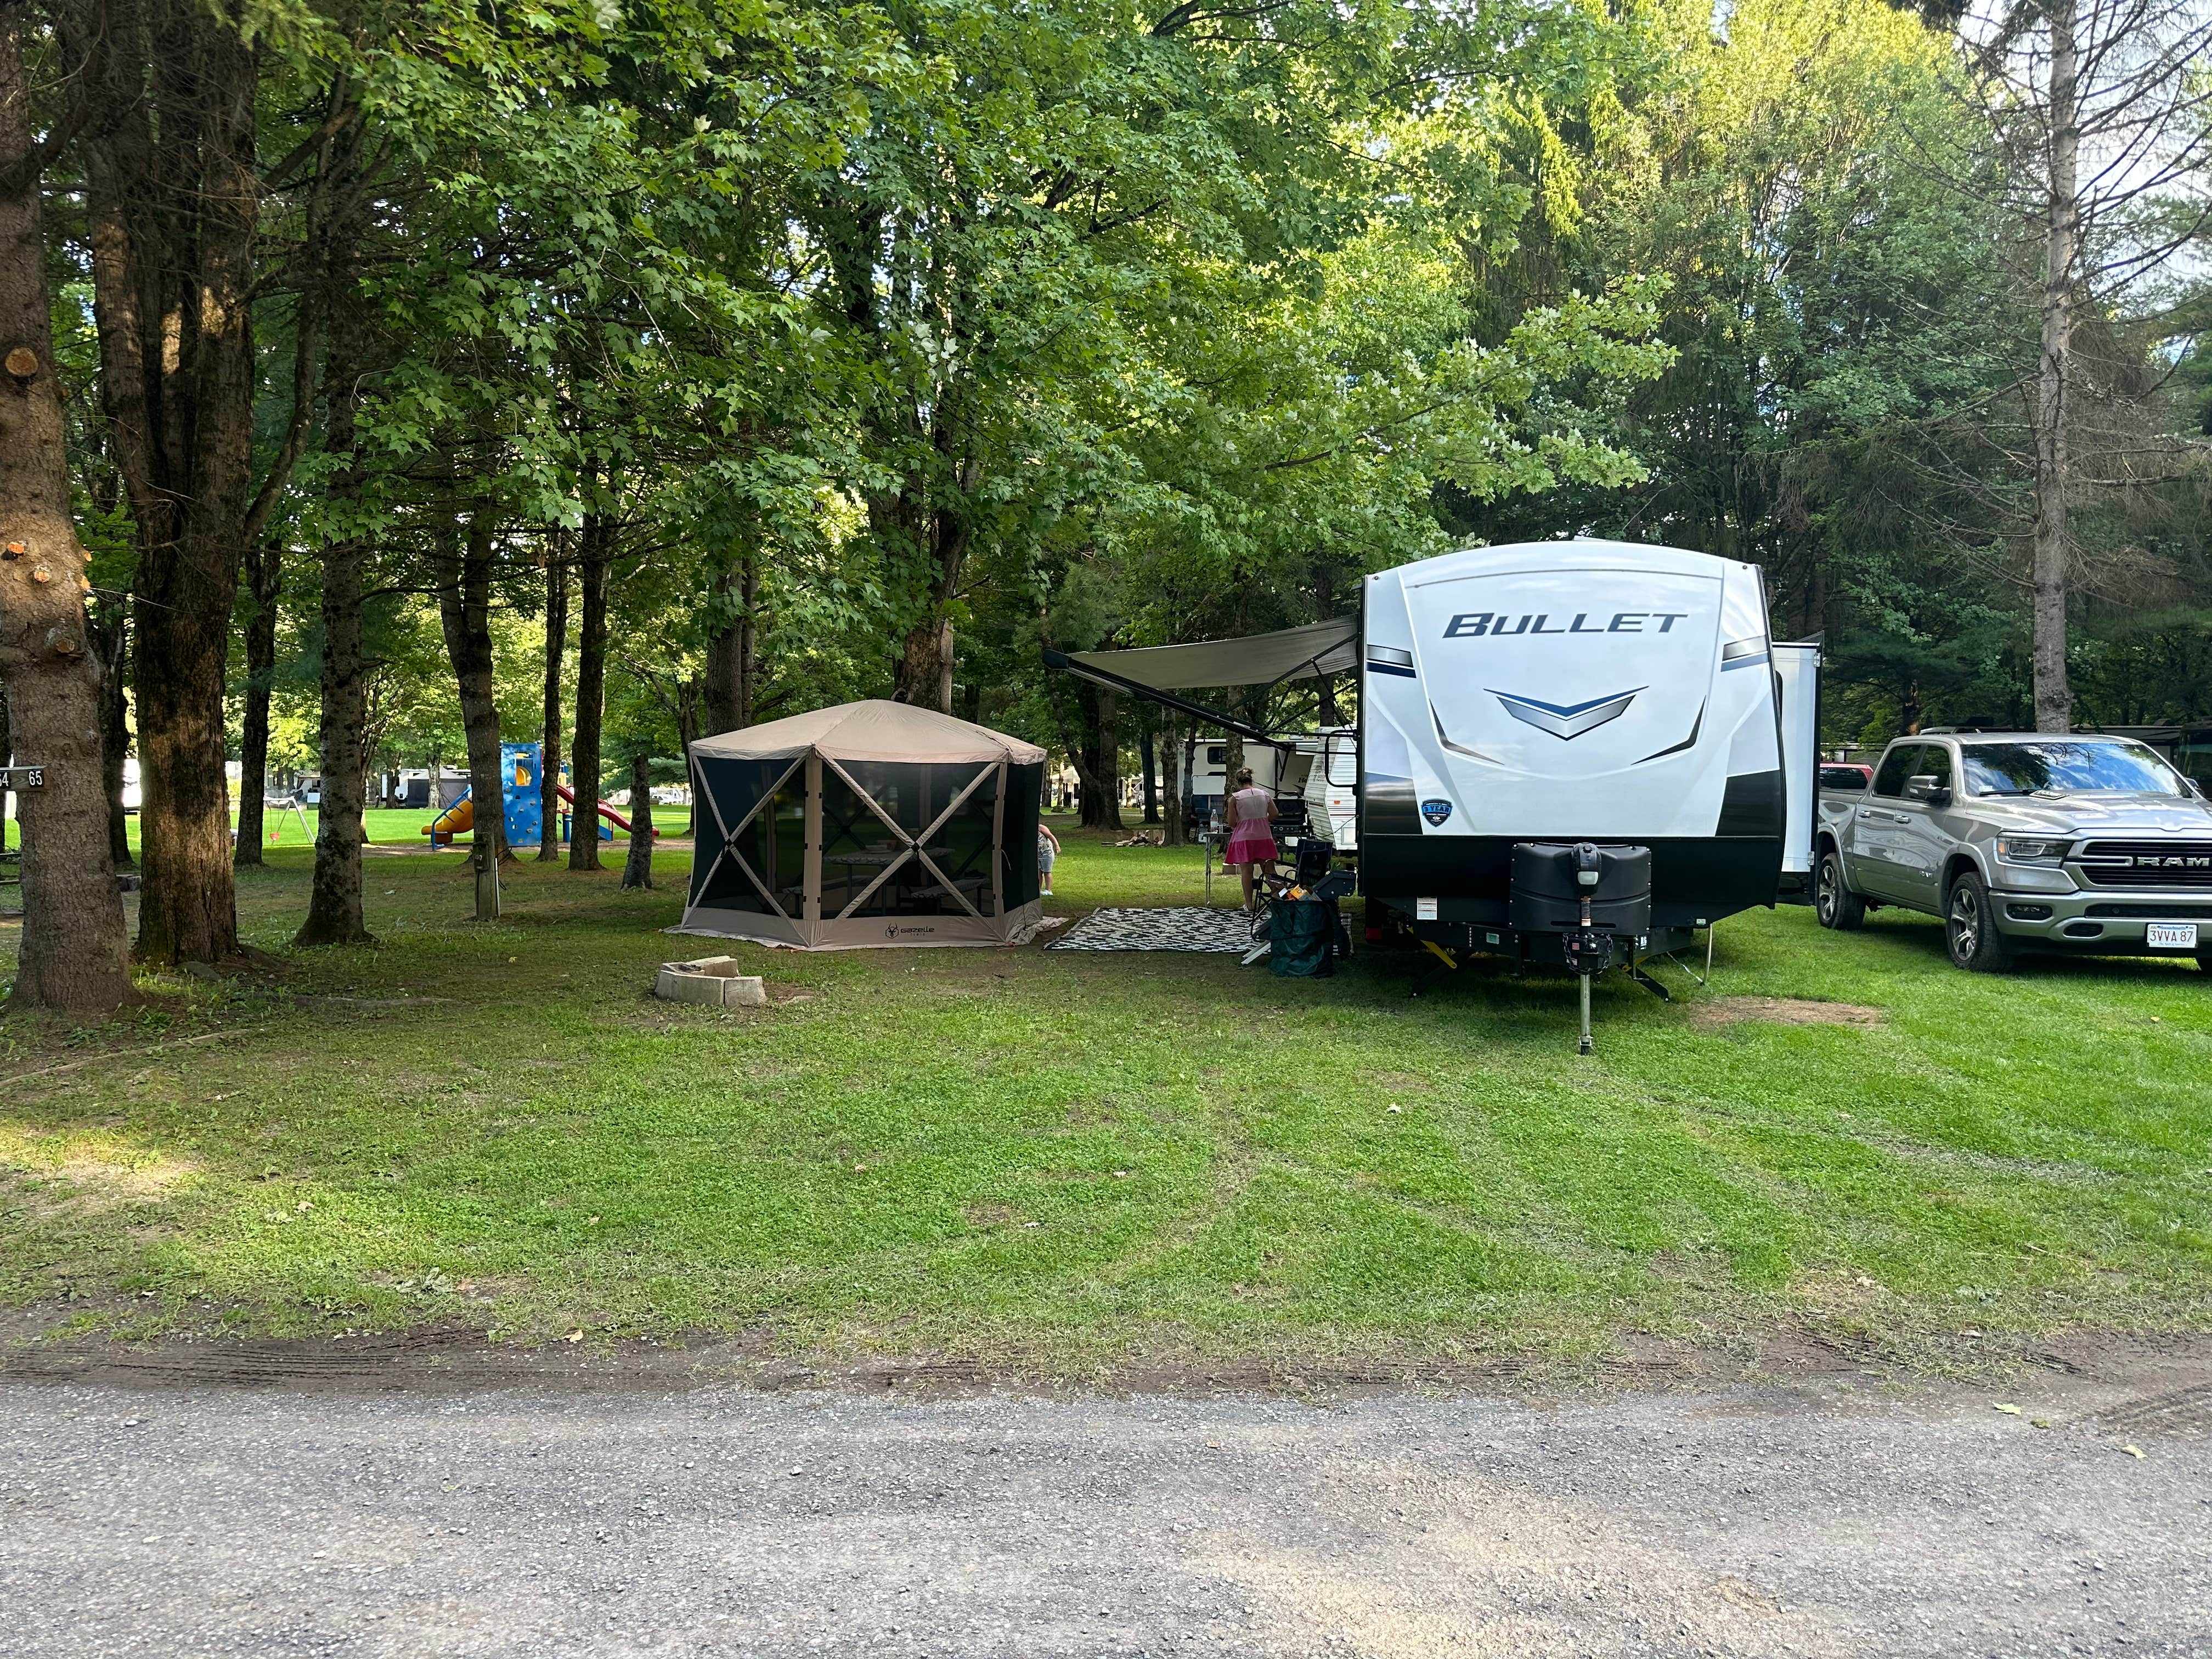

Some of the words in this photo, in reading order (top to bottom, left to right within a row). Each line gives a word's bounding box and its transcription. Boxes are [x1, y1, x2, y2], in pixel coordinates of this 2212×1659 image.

[1442, 612, 1689, 639] BULLET
[0, 772, 9, 787] 4
[29, 770, 42, 786] 65
[2137, 857, 2210, 867] RAM
[2149, 930, 2177, 942] 3VVA
[2180, 931, 2193, 942] 87
